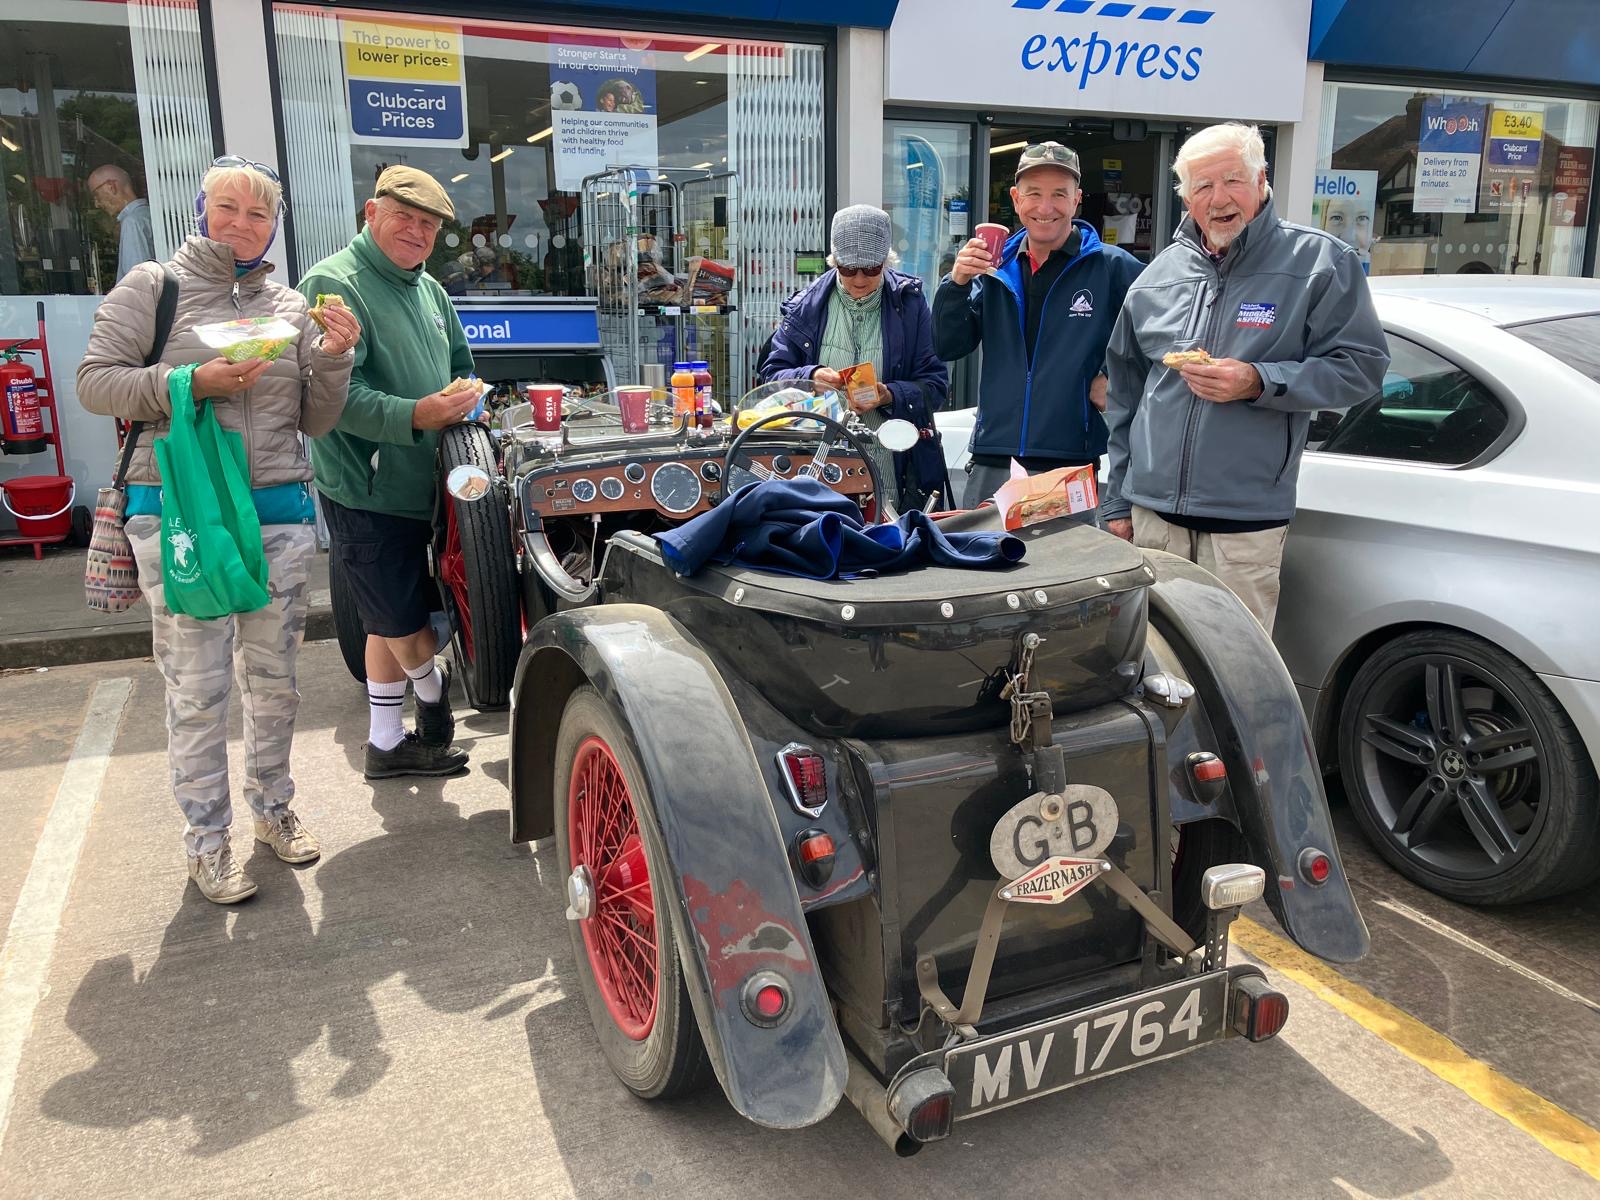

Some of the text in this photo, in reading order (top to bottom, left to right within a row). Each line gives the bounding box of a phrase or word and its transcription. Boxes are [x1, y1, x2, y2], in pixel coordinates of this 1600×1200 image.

[352, 30, 450, 50] The power to
[358, 48, 448, 68] lower prices
[558, 48, 626, 60] Stronger Starts
[1021, 31, 1202, 90] express
[366, 92, 446, 111] Clubcard
[382, 112, 435, 128] Prices
[561, 118, 588, 126] Helping
[604, 120, 648, 128] communities
[1504, 115, 1532, 128] £3.40
[577, 128, 606, 136] children
[580, 138, 606, 146] healthy
[1502, 144, 1528, 152] Clubcard
[578, 147, 606, 156] funding.
[1424, 158, 1468, 167] Delivery from
[1315, 176, 1360, 195] Hello.
[464, 320, 511, 339] onal
[971, 988, 1202, 1108] MV 1764
